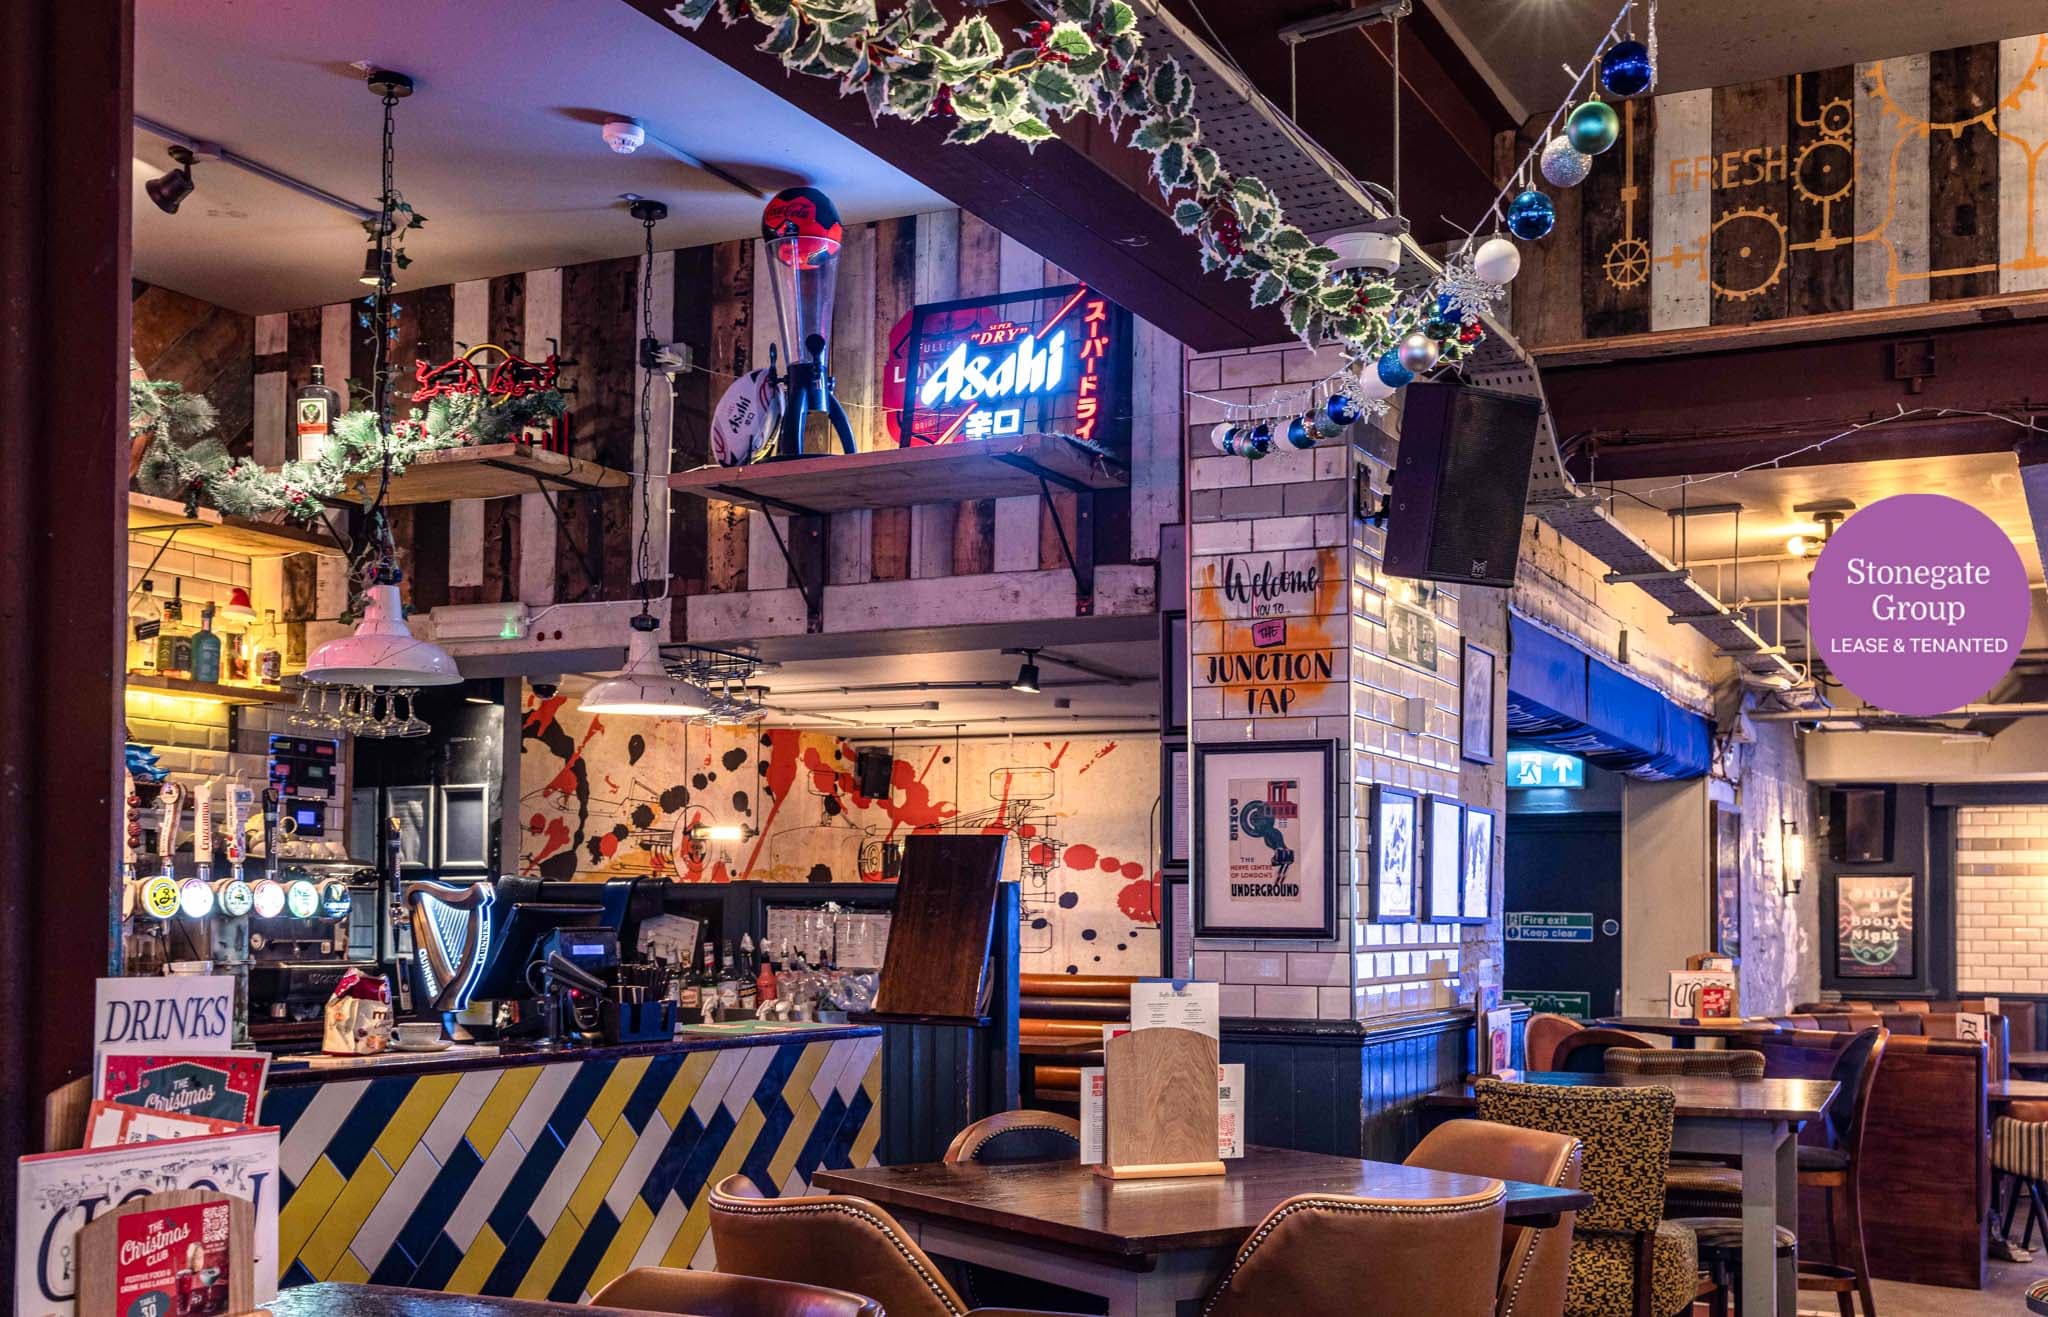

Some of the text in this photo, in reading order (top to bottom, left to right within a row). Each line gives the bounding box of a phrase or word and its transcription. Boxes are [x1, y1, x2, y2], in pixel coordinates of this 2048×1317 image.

[1669, 144, 1787, 198] FRESH
[989, 322, 1012, 331] SUPER
[921, 330, 1066, 406] Asahi
[965, 408, 1021, 441] 辛口
[1225, 557, 1322, 604] Welcome
[1256, 604, 1270, 617] YOU
[1258, 625, 1281, 640] THE
[1207, 650, 1334, 684] JUNCTION
[1244, 688, 1296, 715] TAP
[1231, 883, 1300, 897] UNDERGROUND
[1522, 915, 1568, 925] Fire exit
[1522, 928, 1578, 939] Keep clear
[1851, 929, 1900, 944] Night
[418, 948, 438, 998] GUINNESS
[101, 995, 229, 1043] DRINKS
[173, 1077, 190, 1090] THE
[145, 1084, 216, 1113] Christmas
[147, 1219, 164, 1234] THE
[120, 1222, 190, 1266] Christmas
[146, 1249, 169, 1267] CLUB
[141, 1303, 157, 1317] 30
